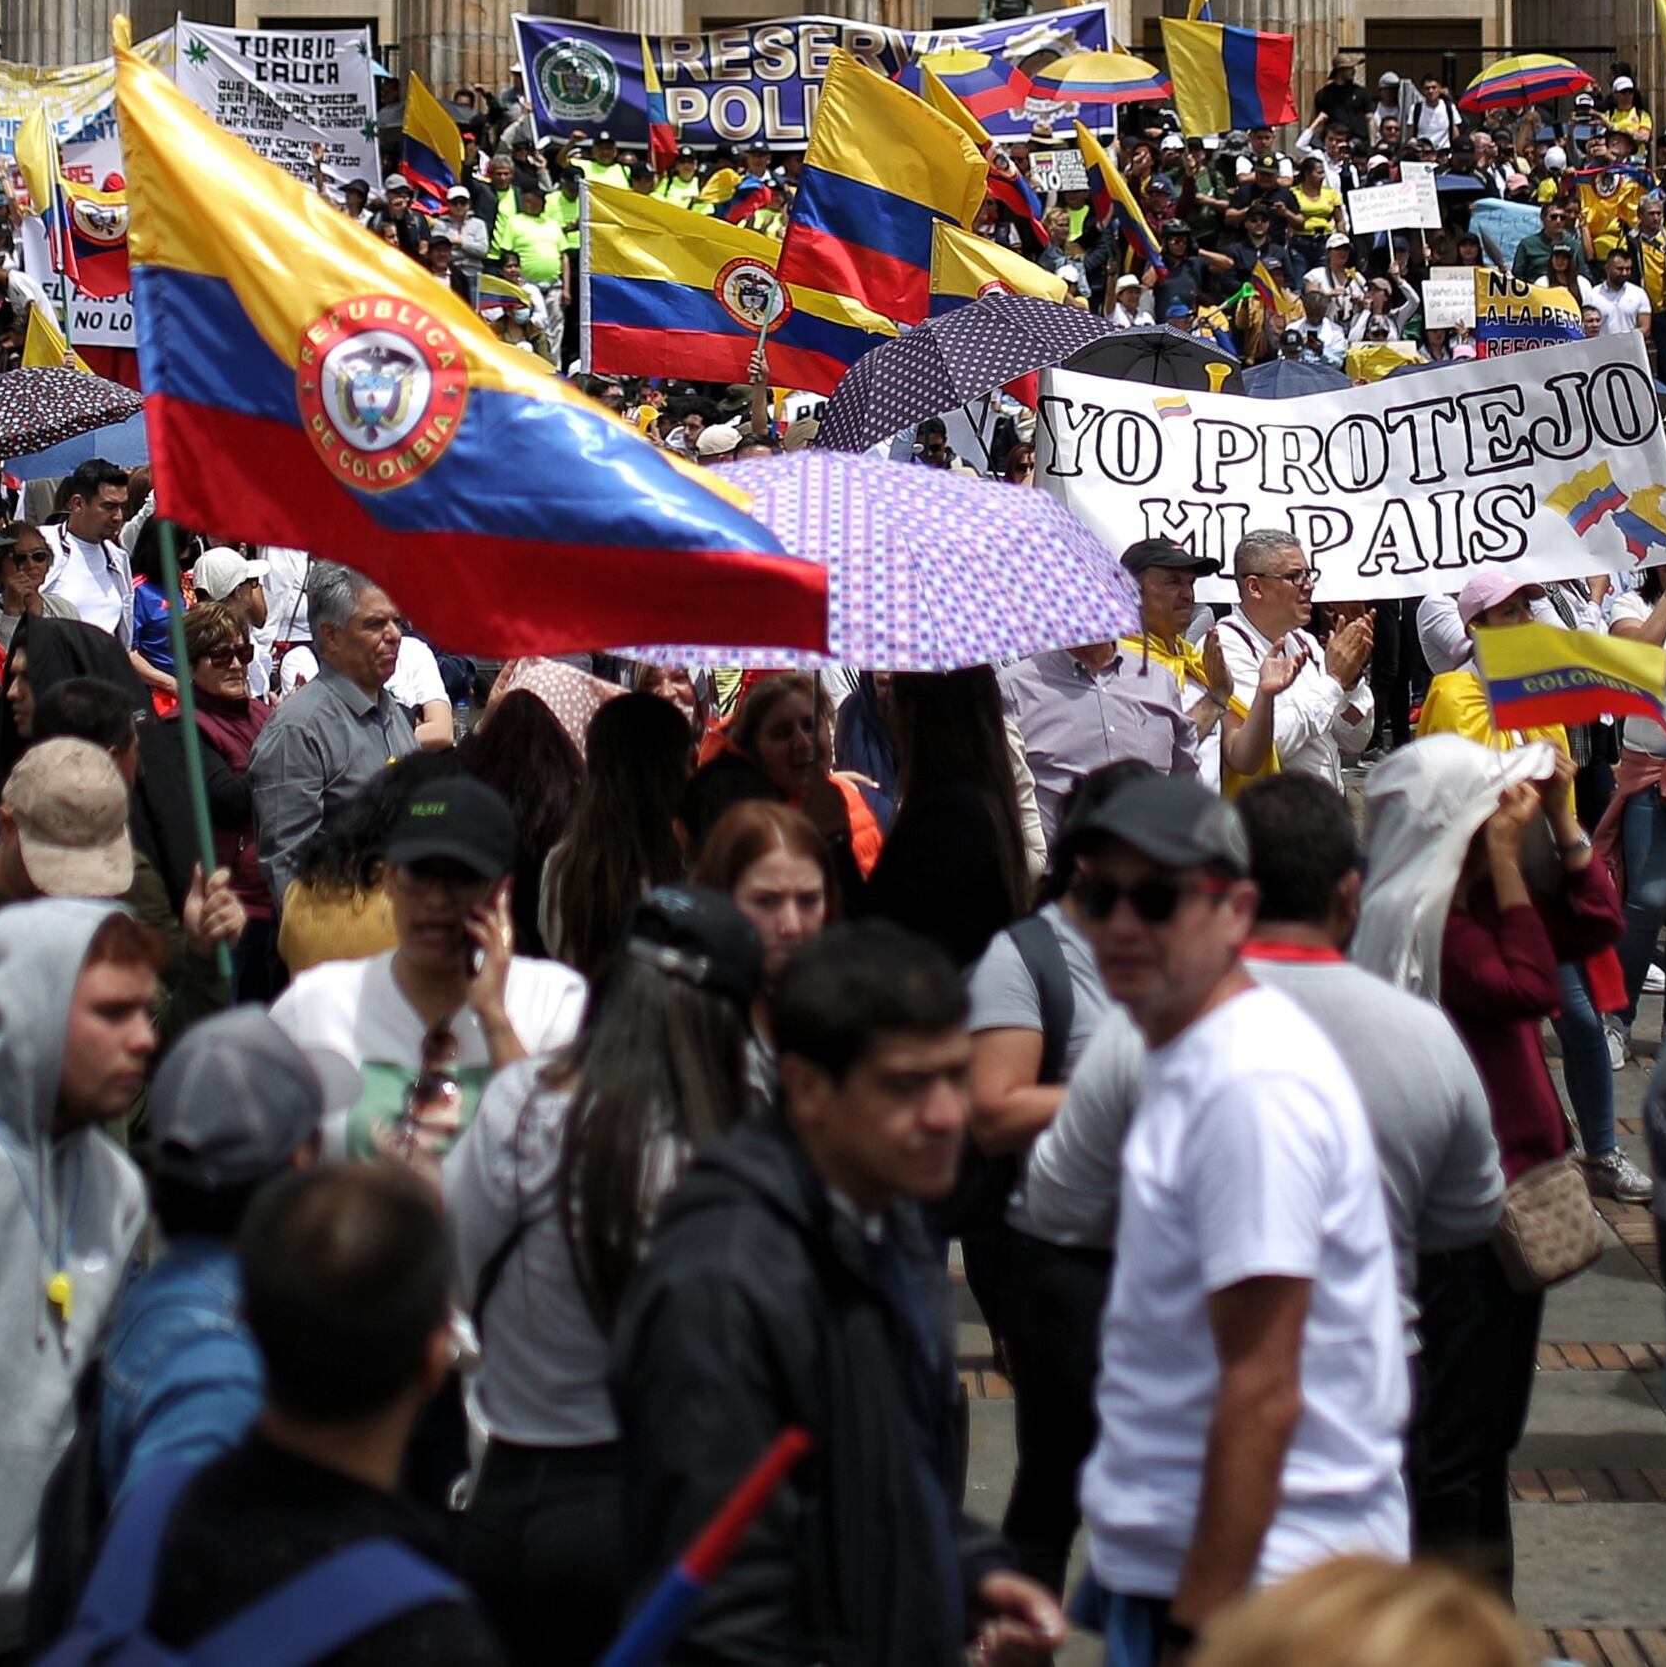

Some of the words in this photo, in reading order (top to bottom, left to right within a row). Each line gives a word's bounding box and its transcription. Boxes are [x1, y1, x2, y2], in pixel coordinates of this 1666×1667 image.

[235, 35, 336, 60] TORIBIO
[254, 61, 340, 85] CAUCA
[229, 105, 248, 118] NO
[665, 84, 814, 141] POLI
[42, 282, 64, 301] EL
[1489, 270, 1530, 298] NO
[74, 310, 103, 330] NO
[108, 312, 133, 332] LO
[1485, 304, 1500, 325] A
[1505, 304, 1533, 325] LA
[1540, 304, 1582, 330] PETR
[301, 300, 455, 369] REPUBLICA
[1037, 393, 1163, 486] YO
[1192, 361, 1661, 497] PROTEJO
[311, 413, 336, 451] DE
[339, 414, 454, 482] COLOMBIA
[1140, 498, 1251, 579] MI
[1286, 484, 1536, 582] PAIS
[1522, 668, 1644, 698] COLOMBIA
